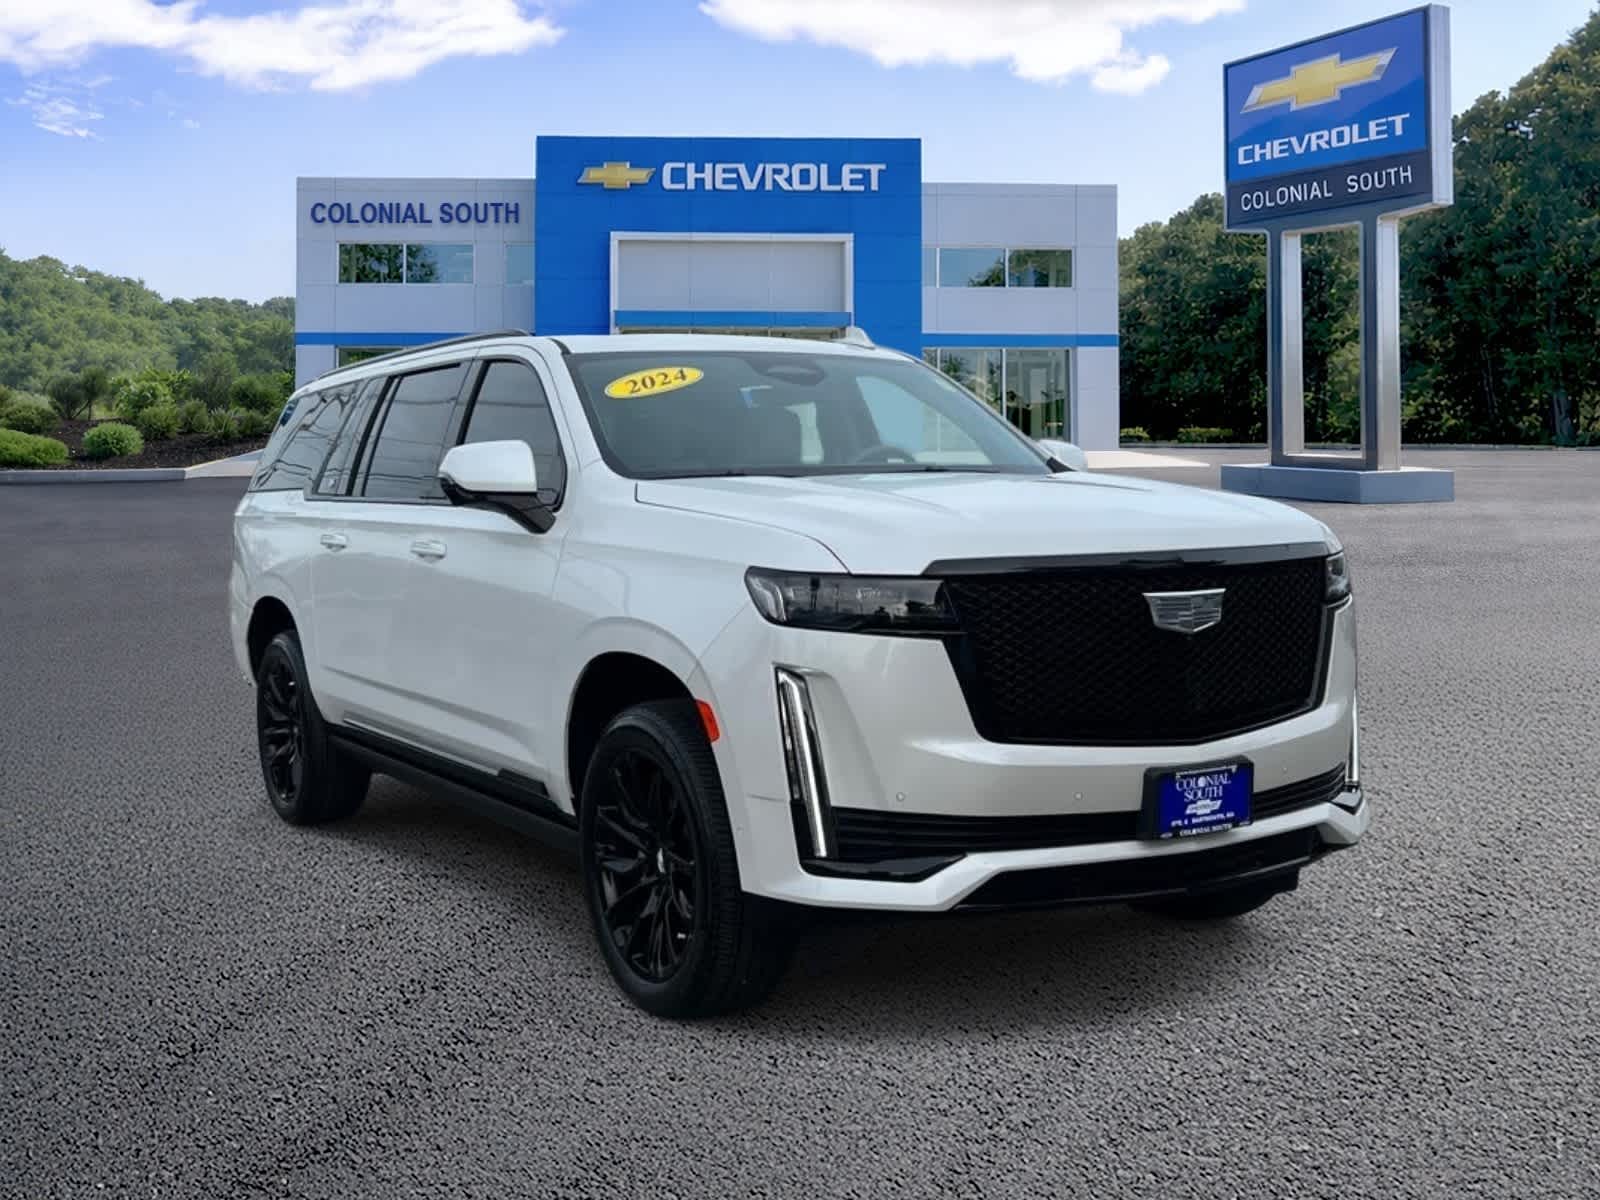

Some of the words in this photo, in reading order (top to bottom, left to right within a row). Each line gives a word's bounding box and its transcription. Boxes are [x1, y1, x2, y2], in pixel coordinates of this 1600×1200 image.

[1238, 113, 1410, 165] CHEVROLET
[662, 161, 886, 191] CHEVROLET
[1241, 181, 1333, 211] COLONIAL
[1346, 165, 1412, 194] SOUTH
[310, 202, 432, 224] COLONIAL
[440, 201, 520, 224] SOUTH
[627, 368, 687, 394] 2024
[1176, 772, 1231, 791] COLONIAL
[1184, 785, 1223, 802] SOUTH
